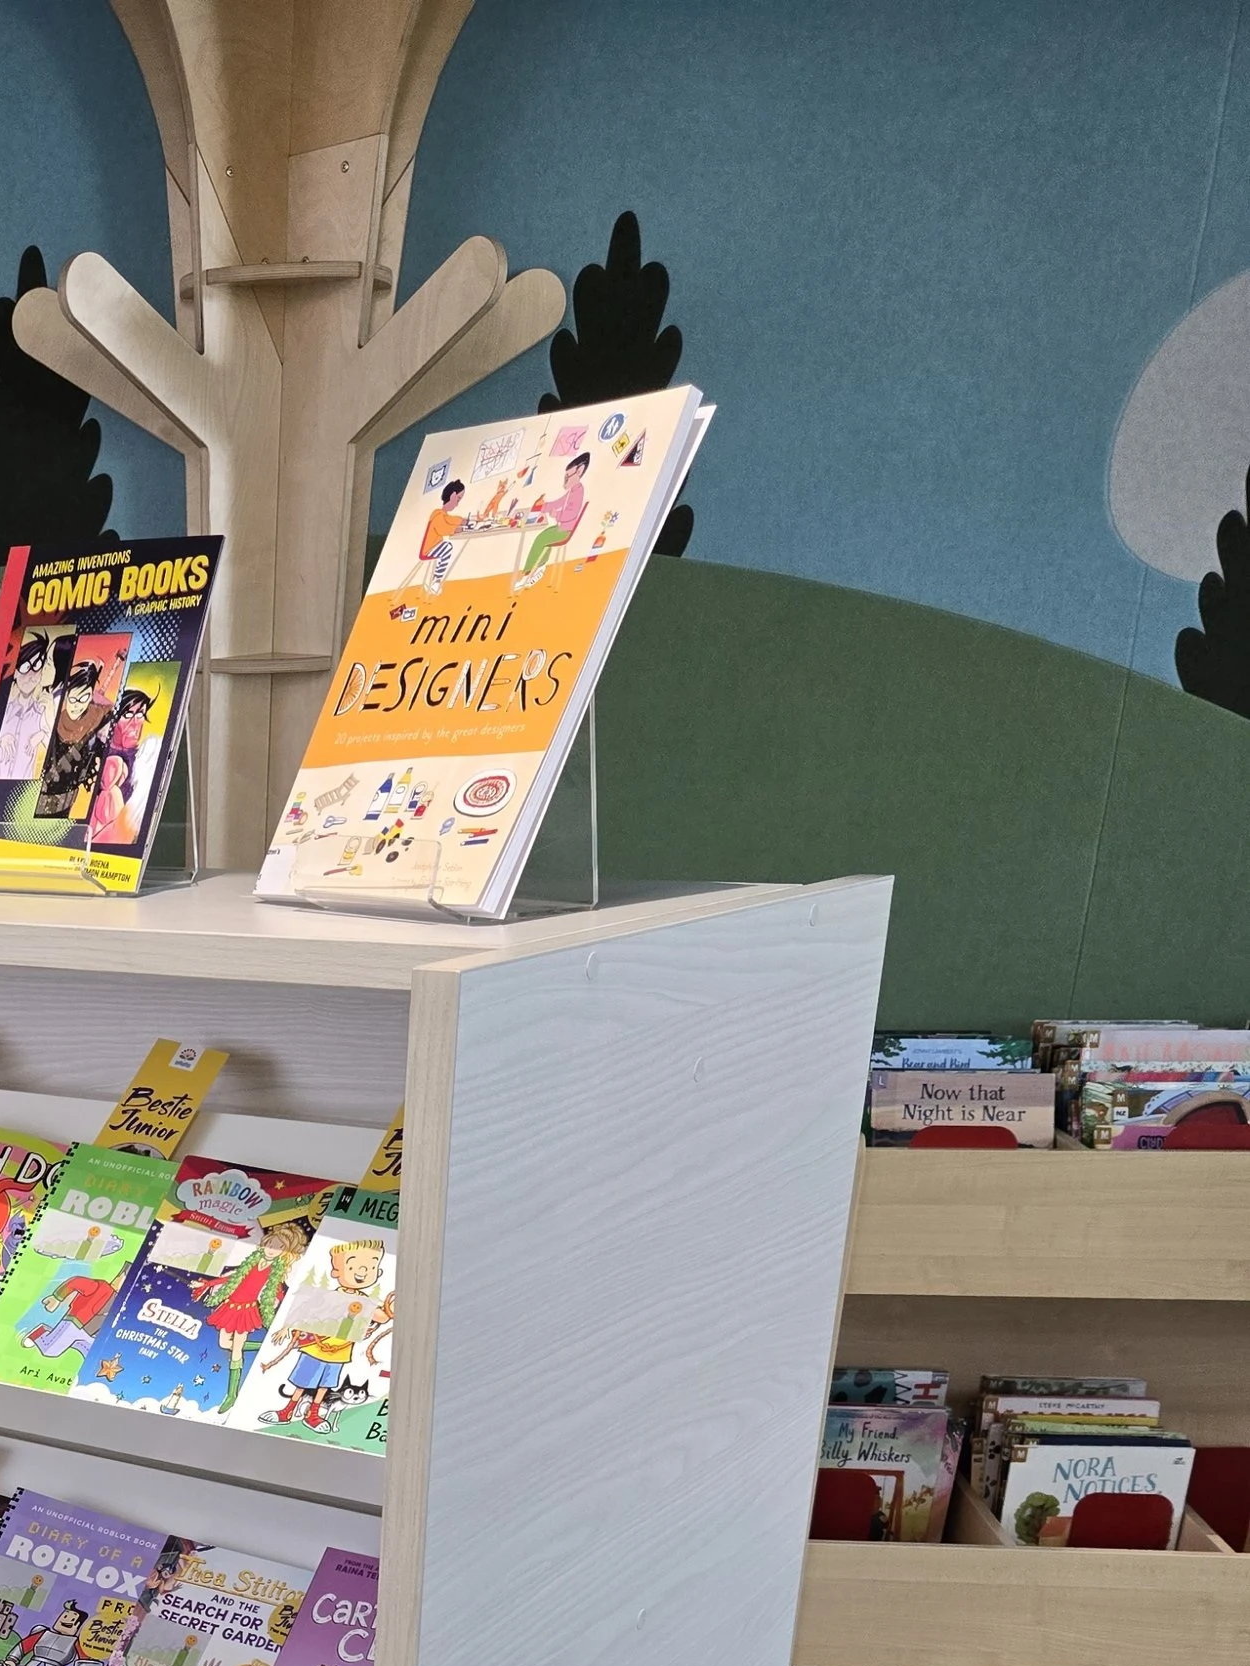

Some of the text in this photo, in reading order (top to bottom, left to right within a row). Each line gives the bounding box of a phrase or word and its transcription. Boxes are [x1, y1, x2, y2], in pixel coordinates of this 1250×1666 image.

[33, 550, 132, 579] AMAZING INVENTIONS
[27, 555, 210, 616] COMIC BOOKS
[126, 594, 202, 617] A GRAPHIC HISTORY
[410, 602, 517, 644] mini
[334, 649, 573, 716] DESIGNERS
[123, 1086, 194, 1121] Bestie
[921, 1083, 1006, 1101] Now that
[109, 1108, 180, 1143] Junior
[902, 1104, 1026, 1126] Night is Near
[192, 1177, 264, 1209] RAINBOW
[341, 1195, 352, 1204] 14
[198, 1197, 243, 1217] magic
[115, 1328, 190, 1364] CHRISTMAS STAR
[154, 1327, 168, 1338] THE
[138, 1347, 159, 1360] FAIRY
[857, 1442, 912, 1463] Whiskers
[1053, 1456, 1116, 1484] NORA
[32, 1505, 158, 1550] AN UNOFFICIAL ROBLOX BOOK
[28, 1521, 143, 1569] DIARY OF A
[5, 1534, 147, 1599] ROBLOX
[335, 1564, 364, 1577] RAINA
[162, 1594, 227, 1622] SEARCH
[229, 1612, 264, 1631] FOR
[210, 1594, 261, 1614] AND THE
[89, 1619, 124, 1637] Bestie
[159, 1609, 221, 1636] SECRET
[86, 1630, 118, 1646] Junior
